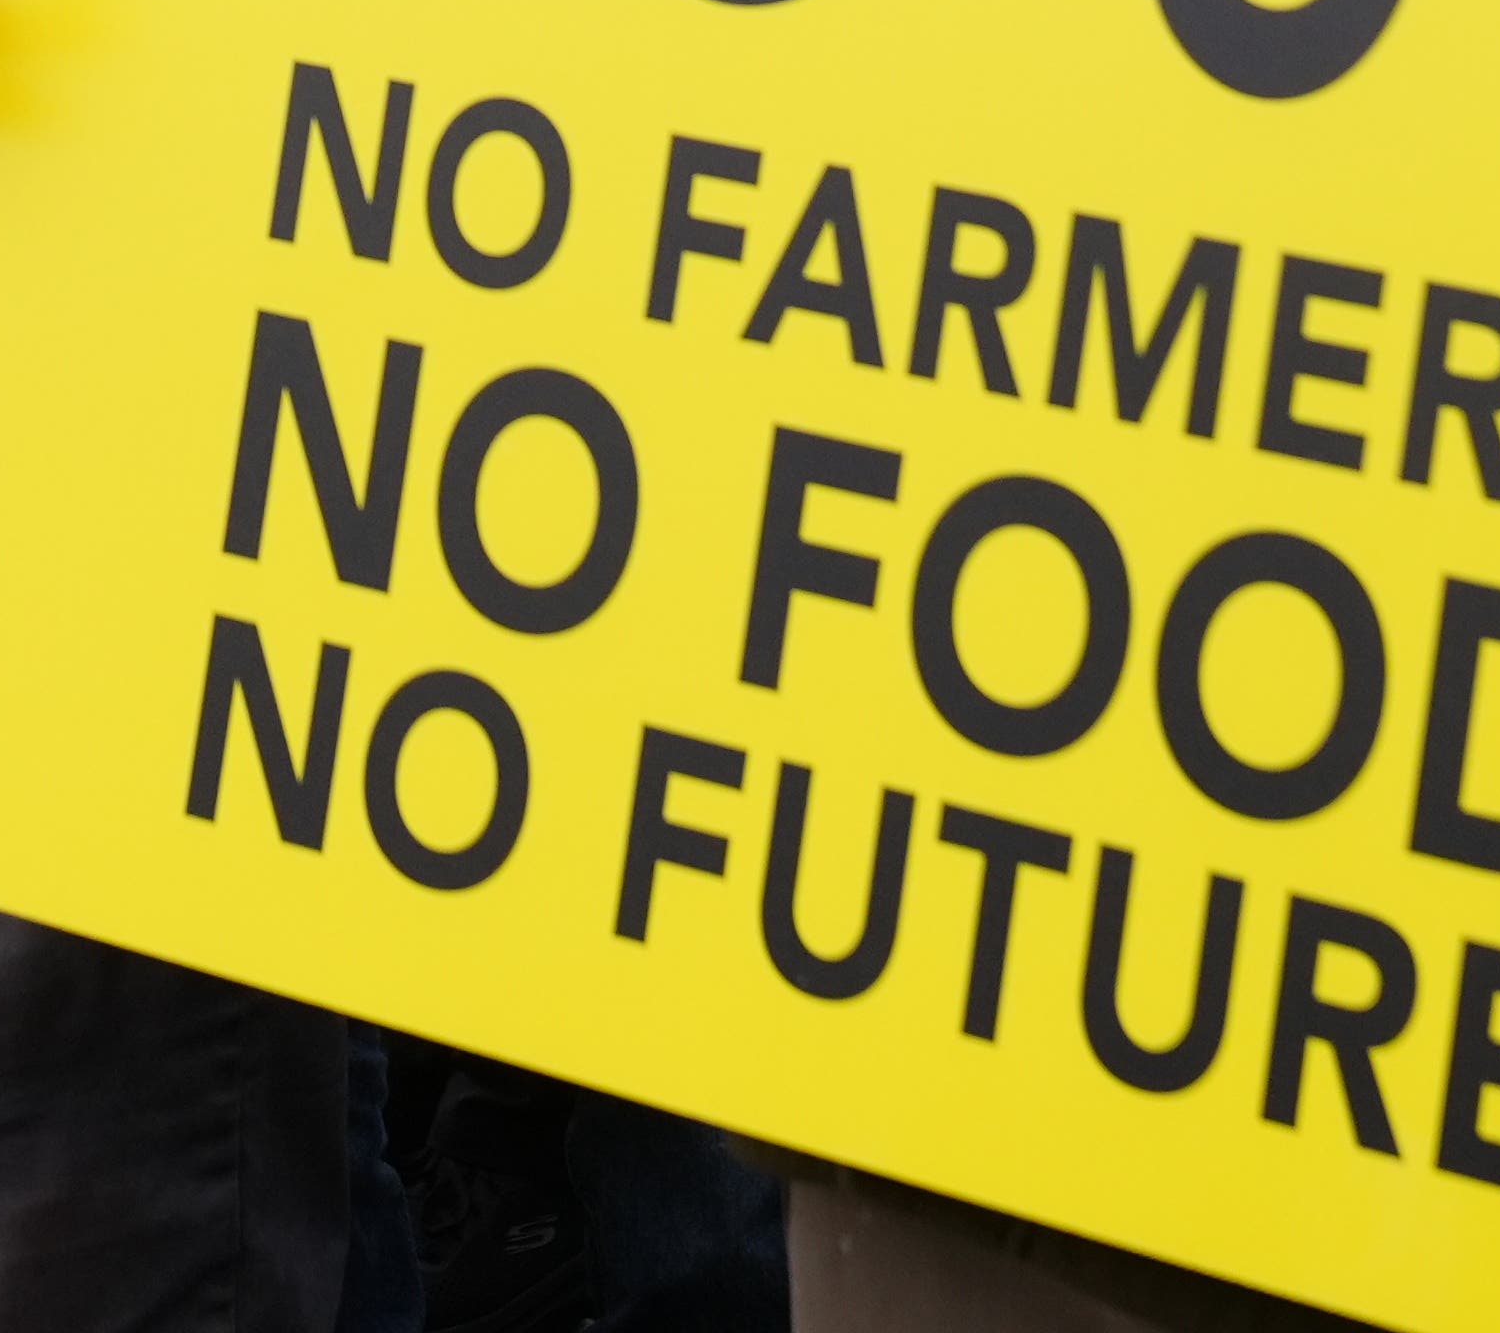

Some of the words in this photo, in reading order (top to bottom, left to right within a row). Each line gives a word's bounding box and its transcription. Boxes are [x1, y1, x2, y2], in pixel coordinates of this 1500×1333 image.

[268, 61, 573, 291] NO
[221, 309, 640, 636] NO
[184, 613, 531, 893] NO
